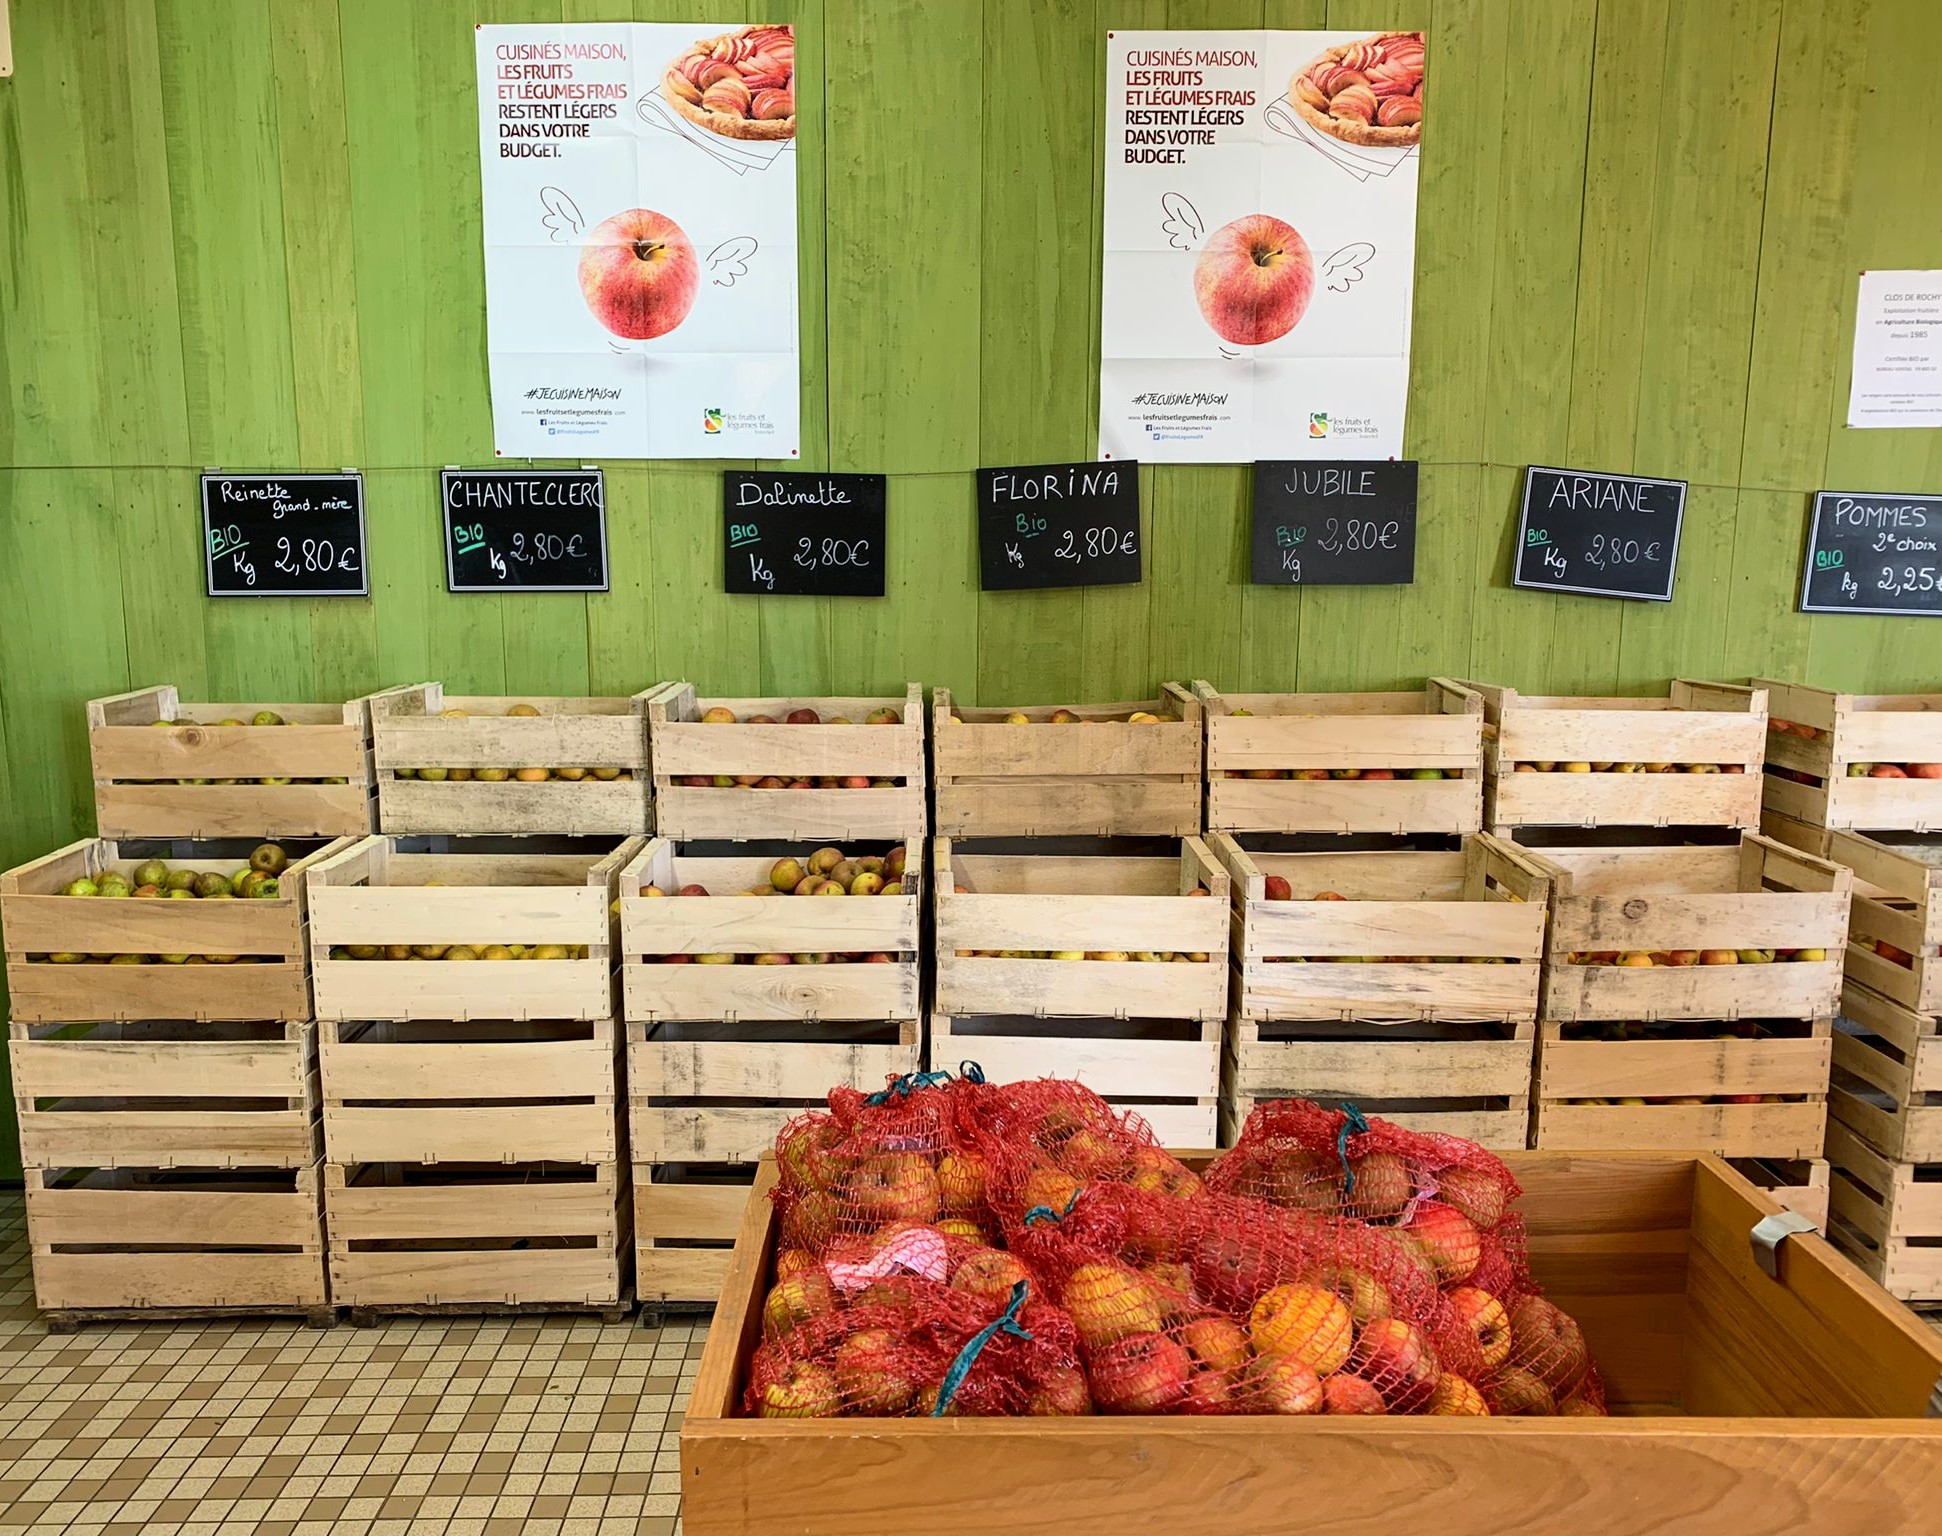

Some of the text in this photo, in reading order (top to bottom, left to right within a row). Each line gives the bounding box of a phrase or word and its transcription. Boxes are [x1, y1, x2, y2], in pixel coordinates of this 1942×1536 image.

[496, 41, 627, 61] CUISINÉS MAISON,
[1126, 48, 1258, 68] CUISINÉS MAISON,
[497, 64, 573, 80] LES FRUITS
[1126, 71, 1203, 86] LES FRUITS
[498, 81, 627, 99] ET LÉGUMES FRAIS
[1126, 87, 1255, 106] ET LÉGUMES FRAIS
[499, 100, 616, 119] RESTENT LÉGERS
[1125, 107, 1244, 125] RESTENT LÉGERS
[500, 124, 590, 138] DANS VOTRE
[1125, 130, 1215, 145] DANS VOTRE
[500, 143, 561, 158] BUDGET.
[1124, 149, 1186, 164] BUDGET.
[523, 387, 622, 402] #JECUISINEMAISON
[1131, 393, 1229, 407] #JECUISINEMAISON
[221, 481, 291, 502] Reinette
[1285, 468, 1376, 497] JUBILE
[736, 481, 852, 506] Dalinette
[1549, 477, 1655, 513] ARIANE
[1835, 498, 1927, 528] POMMES
[210, 524, 242, 554] BIO
[454, 523, 484, 544] BIO
[730, 524, 758, 542] BIO
[1527, 528, 1548, 543] BIO
[510, 532, 587, 566] 2,80€
[1054, 526, 1137, 564] 2,80€
[1282, 517, 1399, 582] Kg 2,80€
[1896, 536, 1938, 551] choix
[233, 537, 359, 585] Kg 2,80€
[749, 537, 870, 590] Kg 2,80€
[1544, 534, 1661, 579] Kg 2,80€
[1816, 550, 1844, 568] BIO
